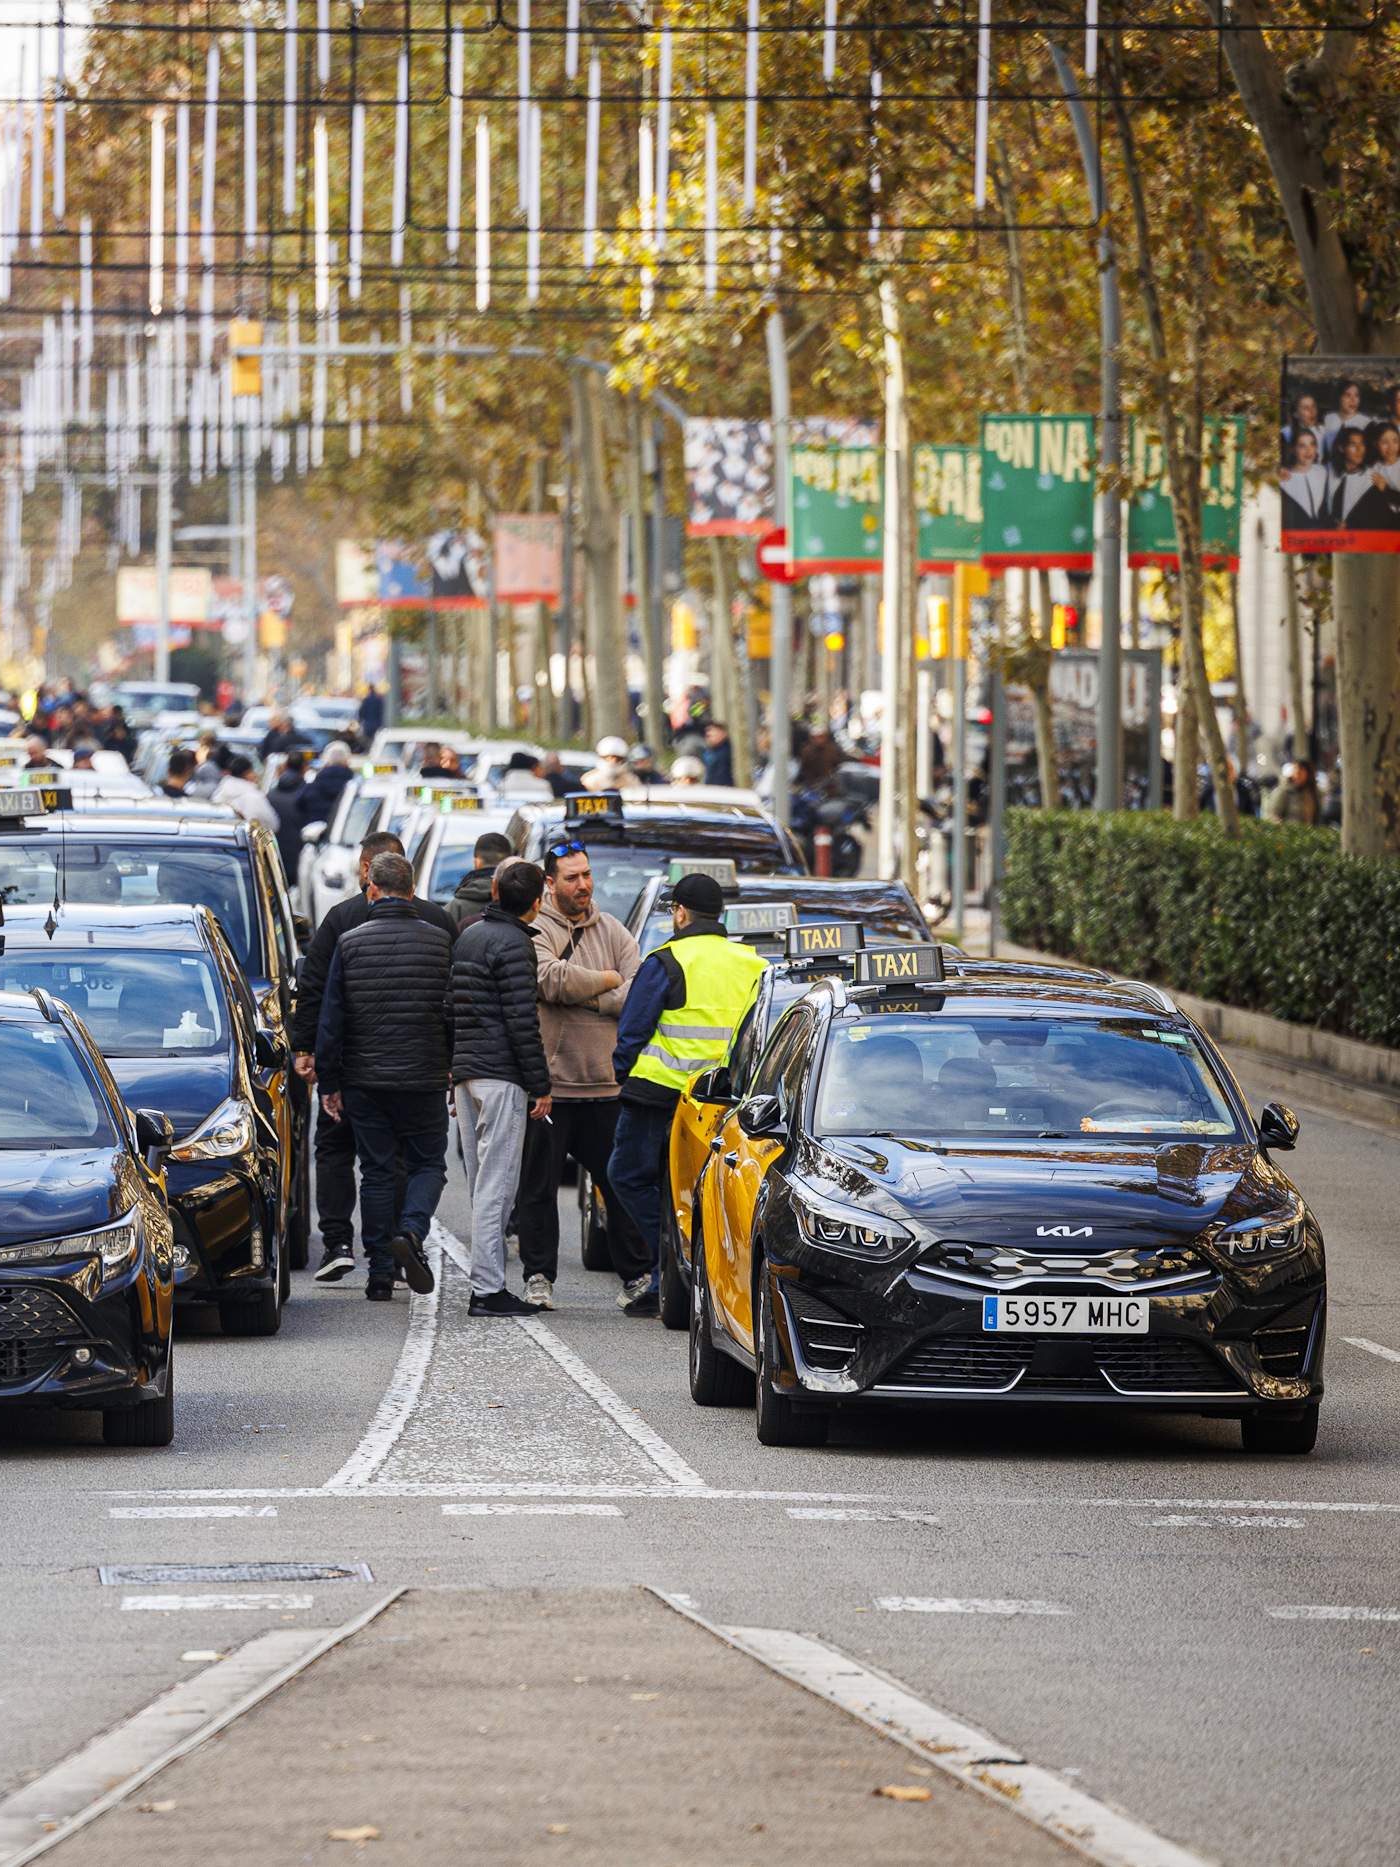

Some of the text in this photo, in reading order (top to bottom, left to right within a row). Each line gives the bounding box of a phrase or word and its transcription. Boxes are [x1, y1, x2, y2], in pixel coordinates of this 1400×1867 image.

[740, 910, 773, 928] TAXI
[800, 927, 841, 950] TAXI
[871, 952, 918, 977] TAXI
[1005, 1301, 1078, 1327] 5957
[1088, 1301, 1141, 1328] MHC
